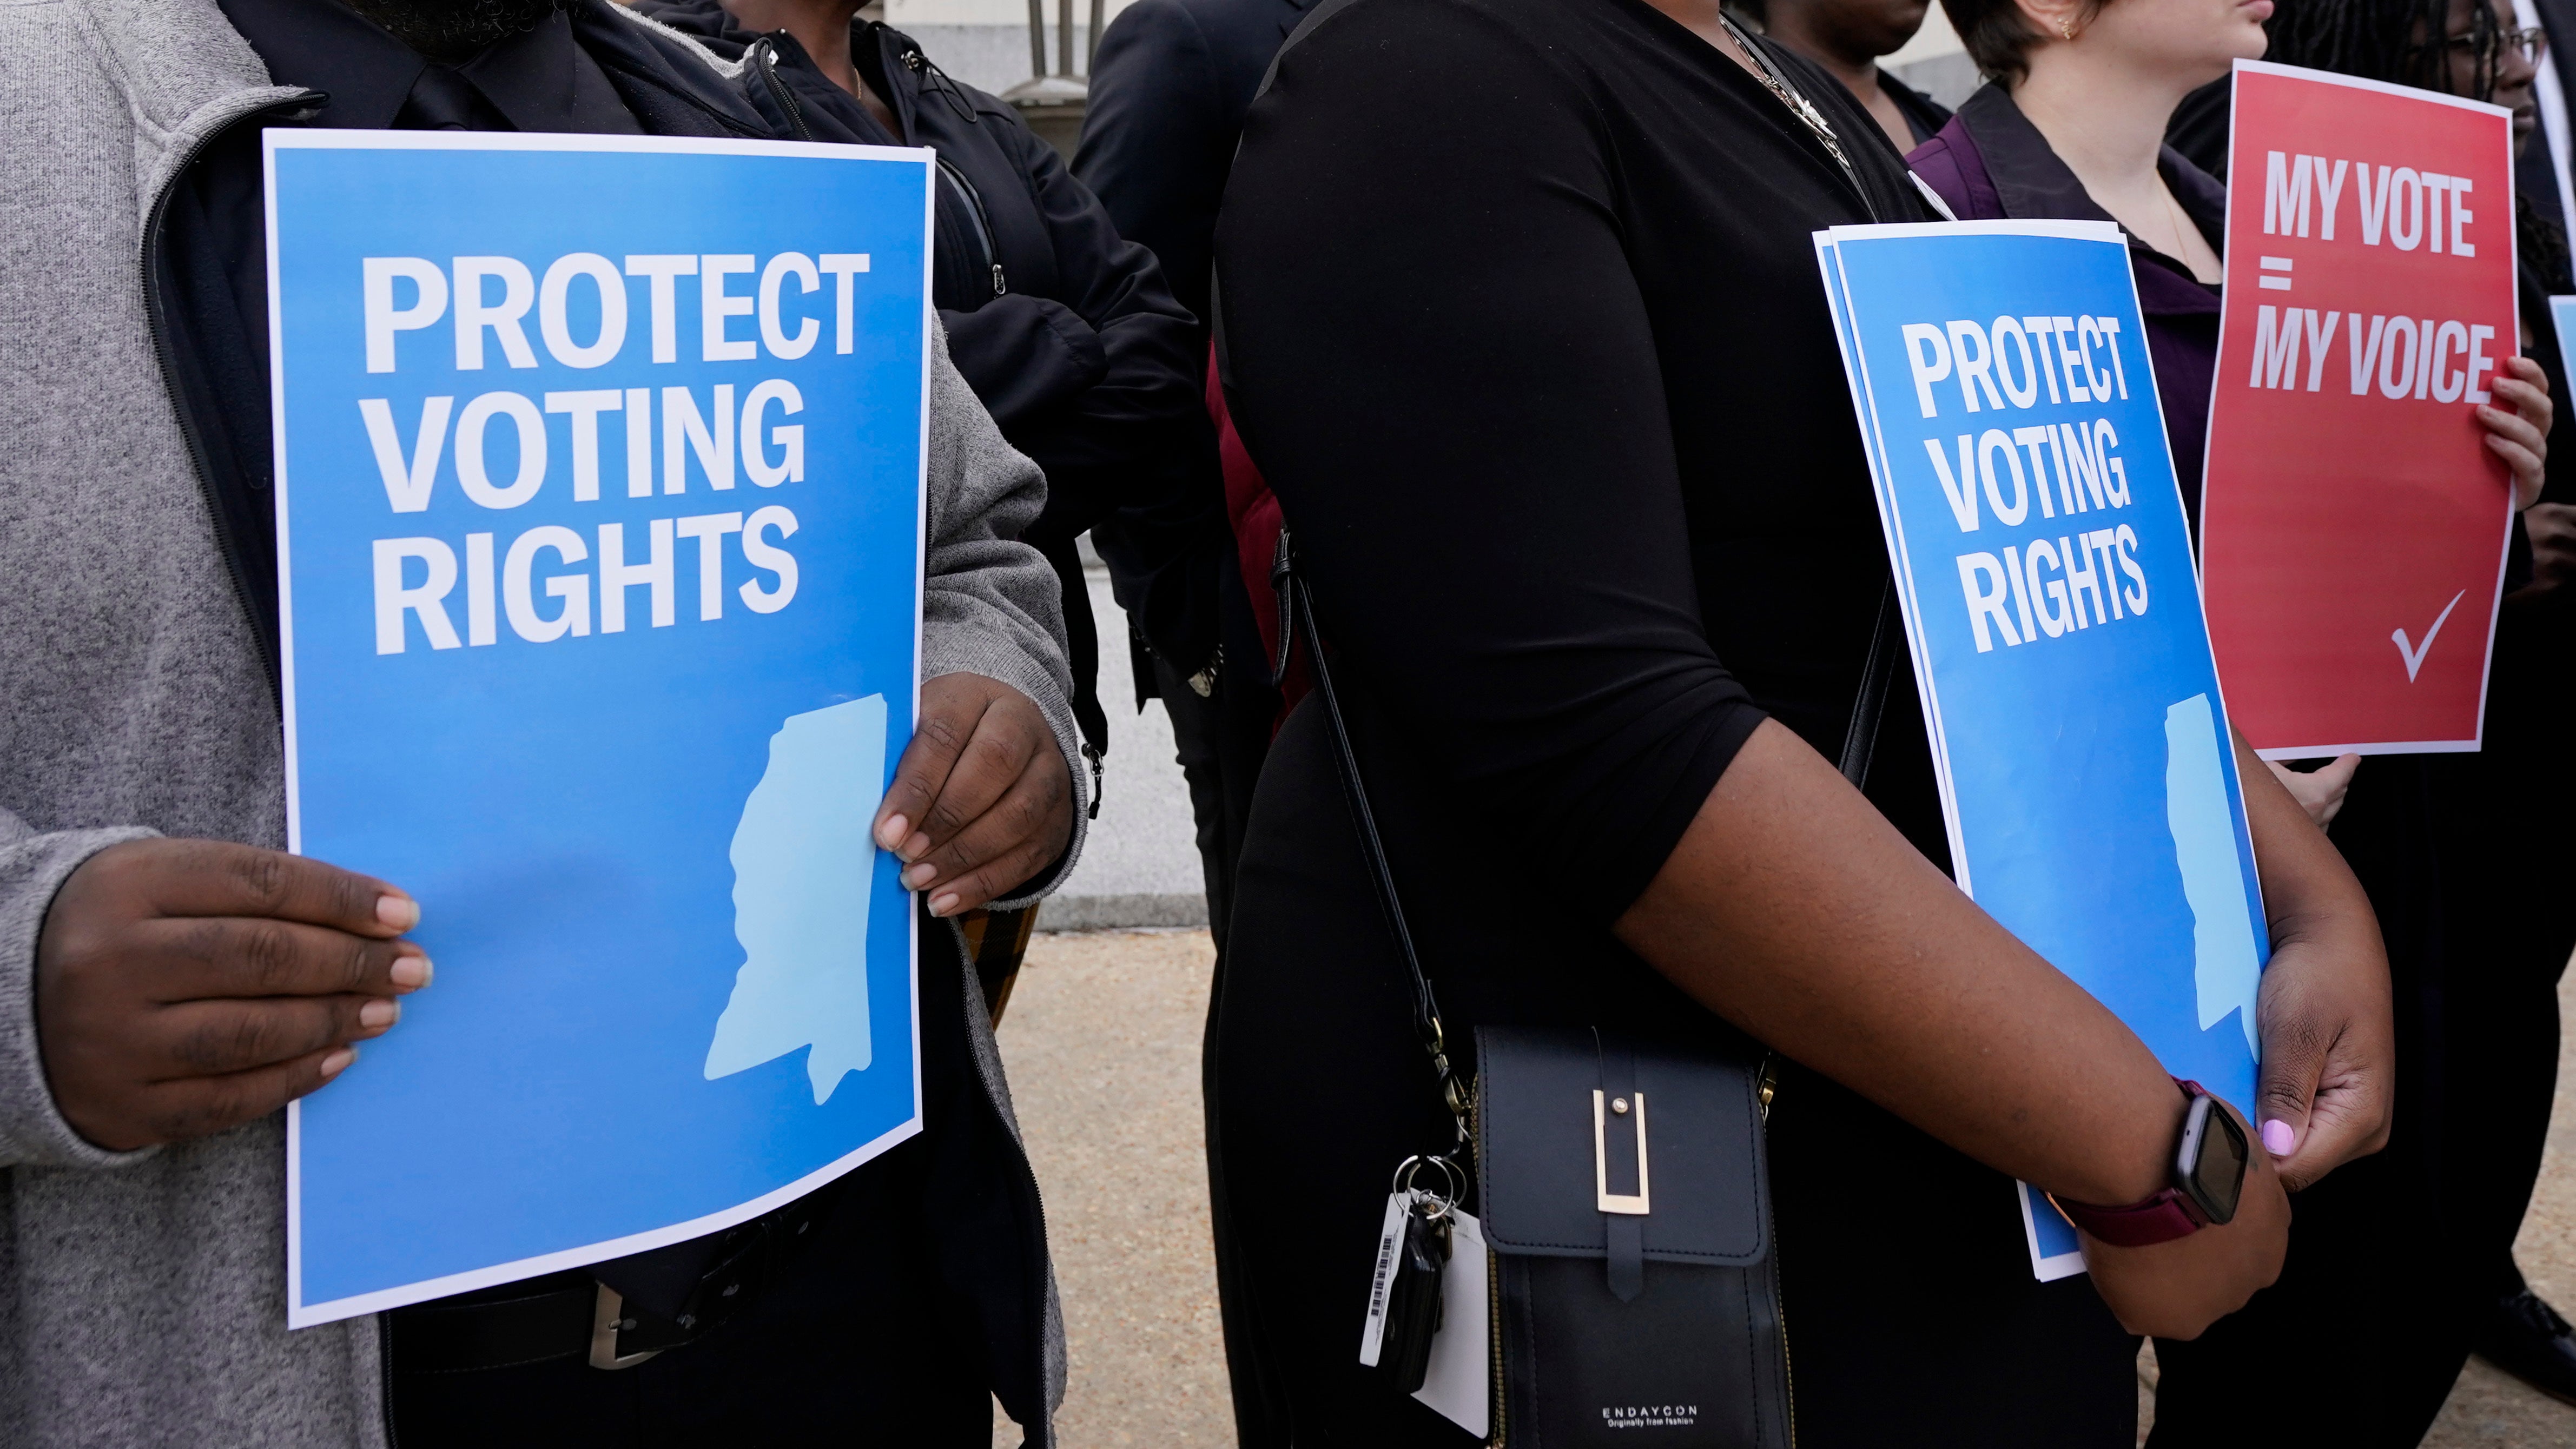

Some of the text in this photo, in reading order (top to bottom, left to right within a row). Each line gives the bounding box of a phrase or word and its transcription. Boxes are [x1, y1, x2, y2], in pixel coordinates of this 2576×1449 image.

[2263, 150, 2475, 257] MY VOTE
[362, 252, 870, 373] PROTECT
[1901, 314, 2128, 419] PROTECT
[2249, 305, 2495, 404] MY VOICE
[358, 379, 804, 513] VOTING
[1923, 418, 2131, 533] VOTING
[372, 505, 799, 655] RIGHTS
[1956, 524, 2148, 653] RIGHTS
[1608, 1417, 1694, 1428] Originally from fashion
